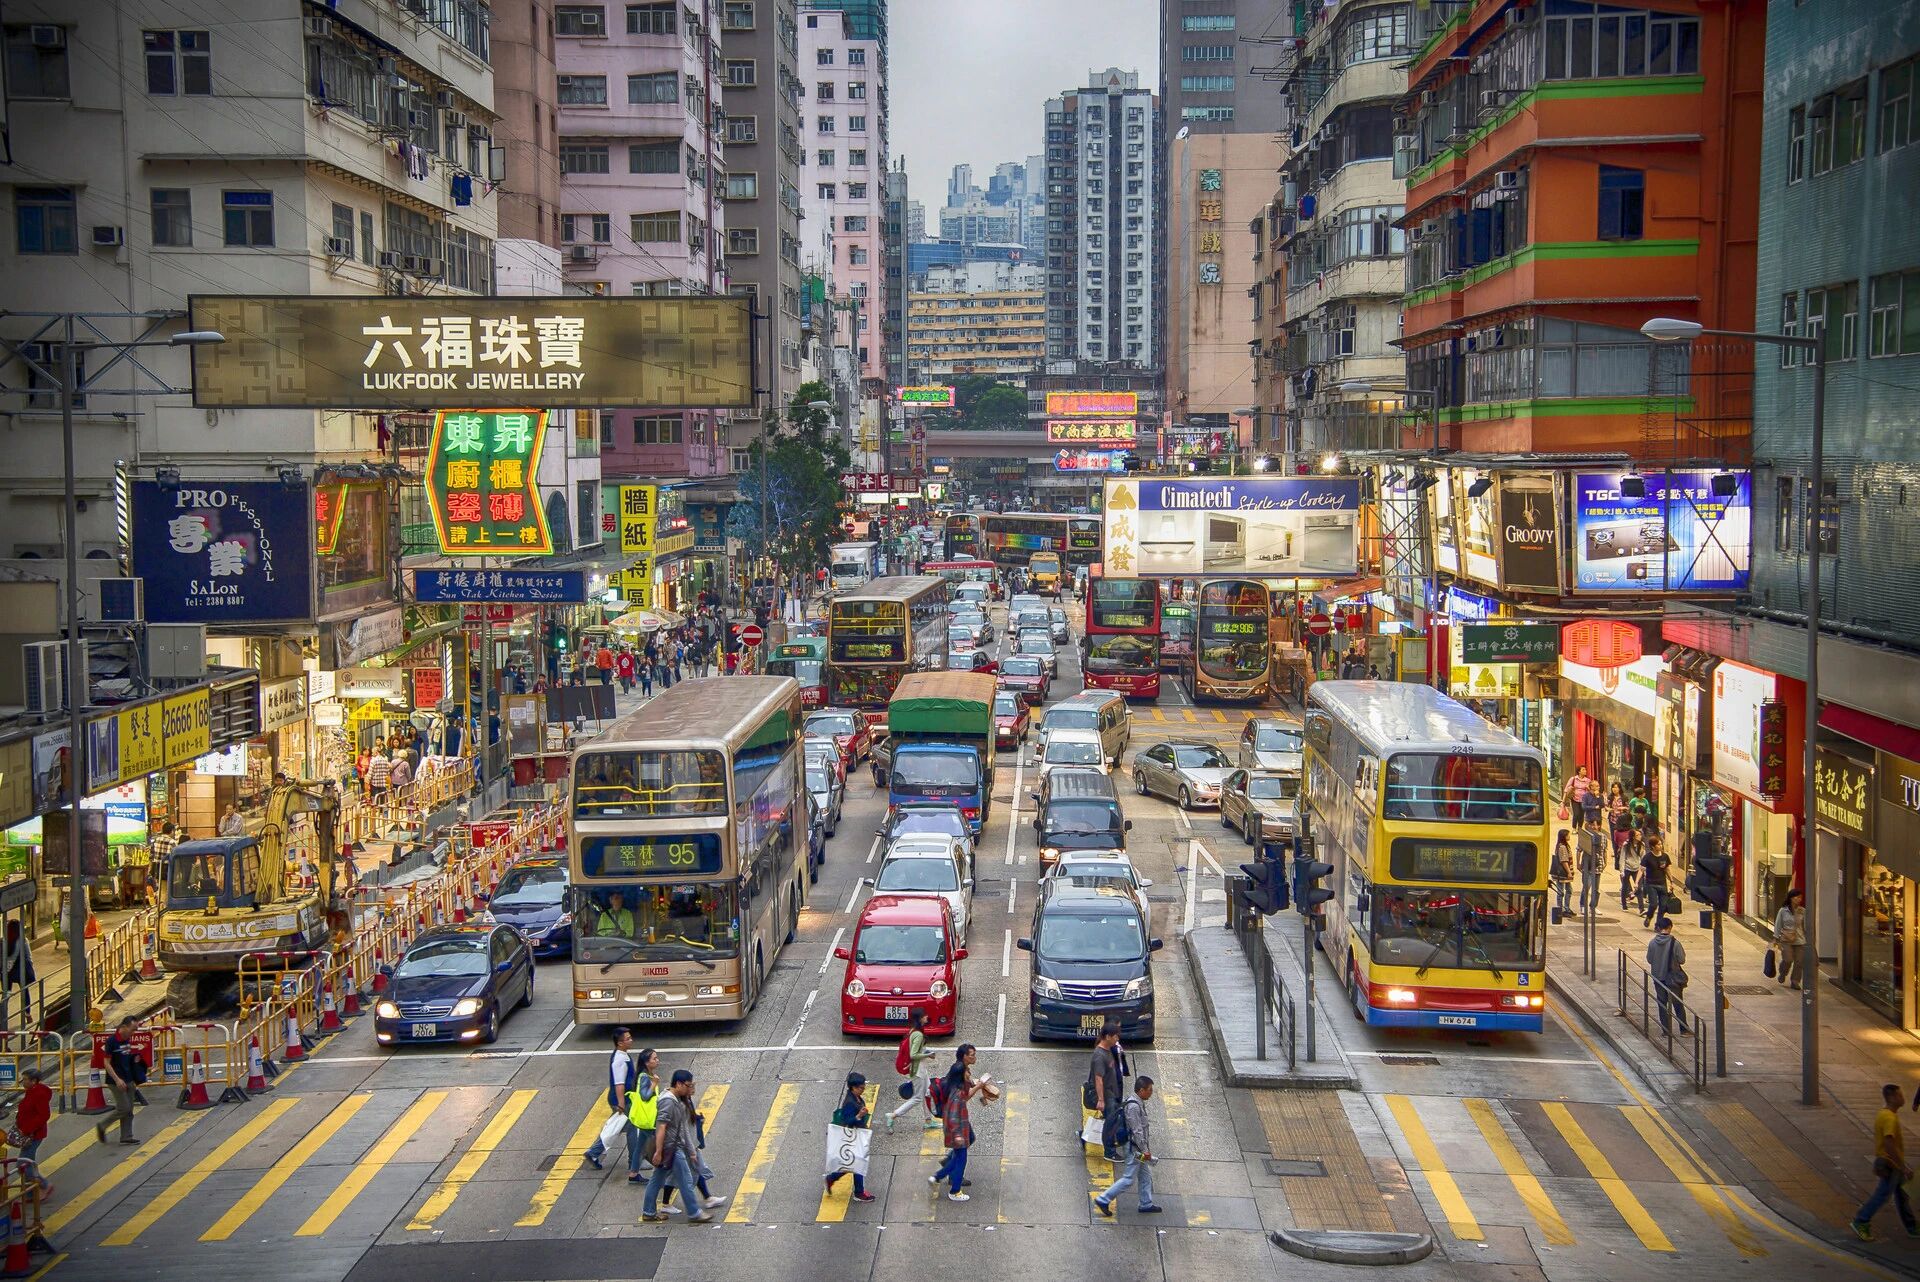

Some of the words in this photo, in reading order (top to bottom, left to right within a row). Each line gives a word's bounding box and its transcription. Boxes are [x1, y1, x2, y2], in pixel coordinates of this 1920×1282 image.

[362, 315, 585, 369] 六福珠寶
[363, 373, 458, 390] LUKFOOK
[466, 373, 585, 390] JEWELLERY
[443, 414, 533, 453] 東昇
[447, 459, 523, 489] 廚櫃
[1299, 490, 1346, 510] Cooking
[1585, 489, 1620, 501] TGC
[447, 492, 523, 522] 瓷磚
[449, 526, 539, 544] 請上一樓
[436, 588, 457, 599] Sun
[461, 588, 482, 598] Tak
[485, 588, 525, 598] Kitchen
[529, 588, 563, 599] Design
[164, 702, 192, 739] 26666
[194, 698, 209, 728] 168
[1451, 746, 1474, 754] 2249
[668, 843, 695, 865] 95
[1477, 851, 1508, 872] E21
[649, 967, 669, 976] KMB
[1443, 1017, 1454, 1025] HW
[1456, 1017, 1471, 1025] 674
[95, 1035, 151, 1043] PEIANS
